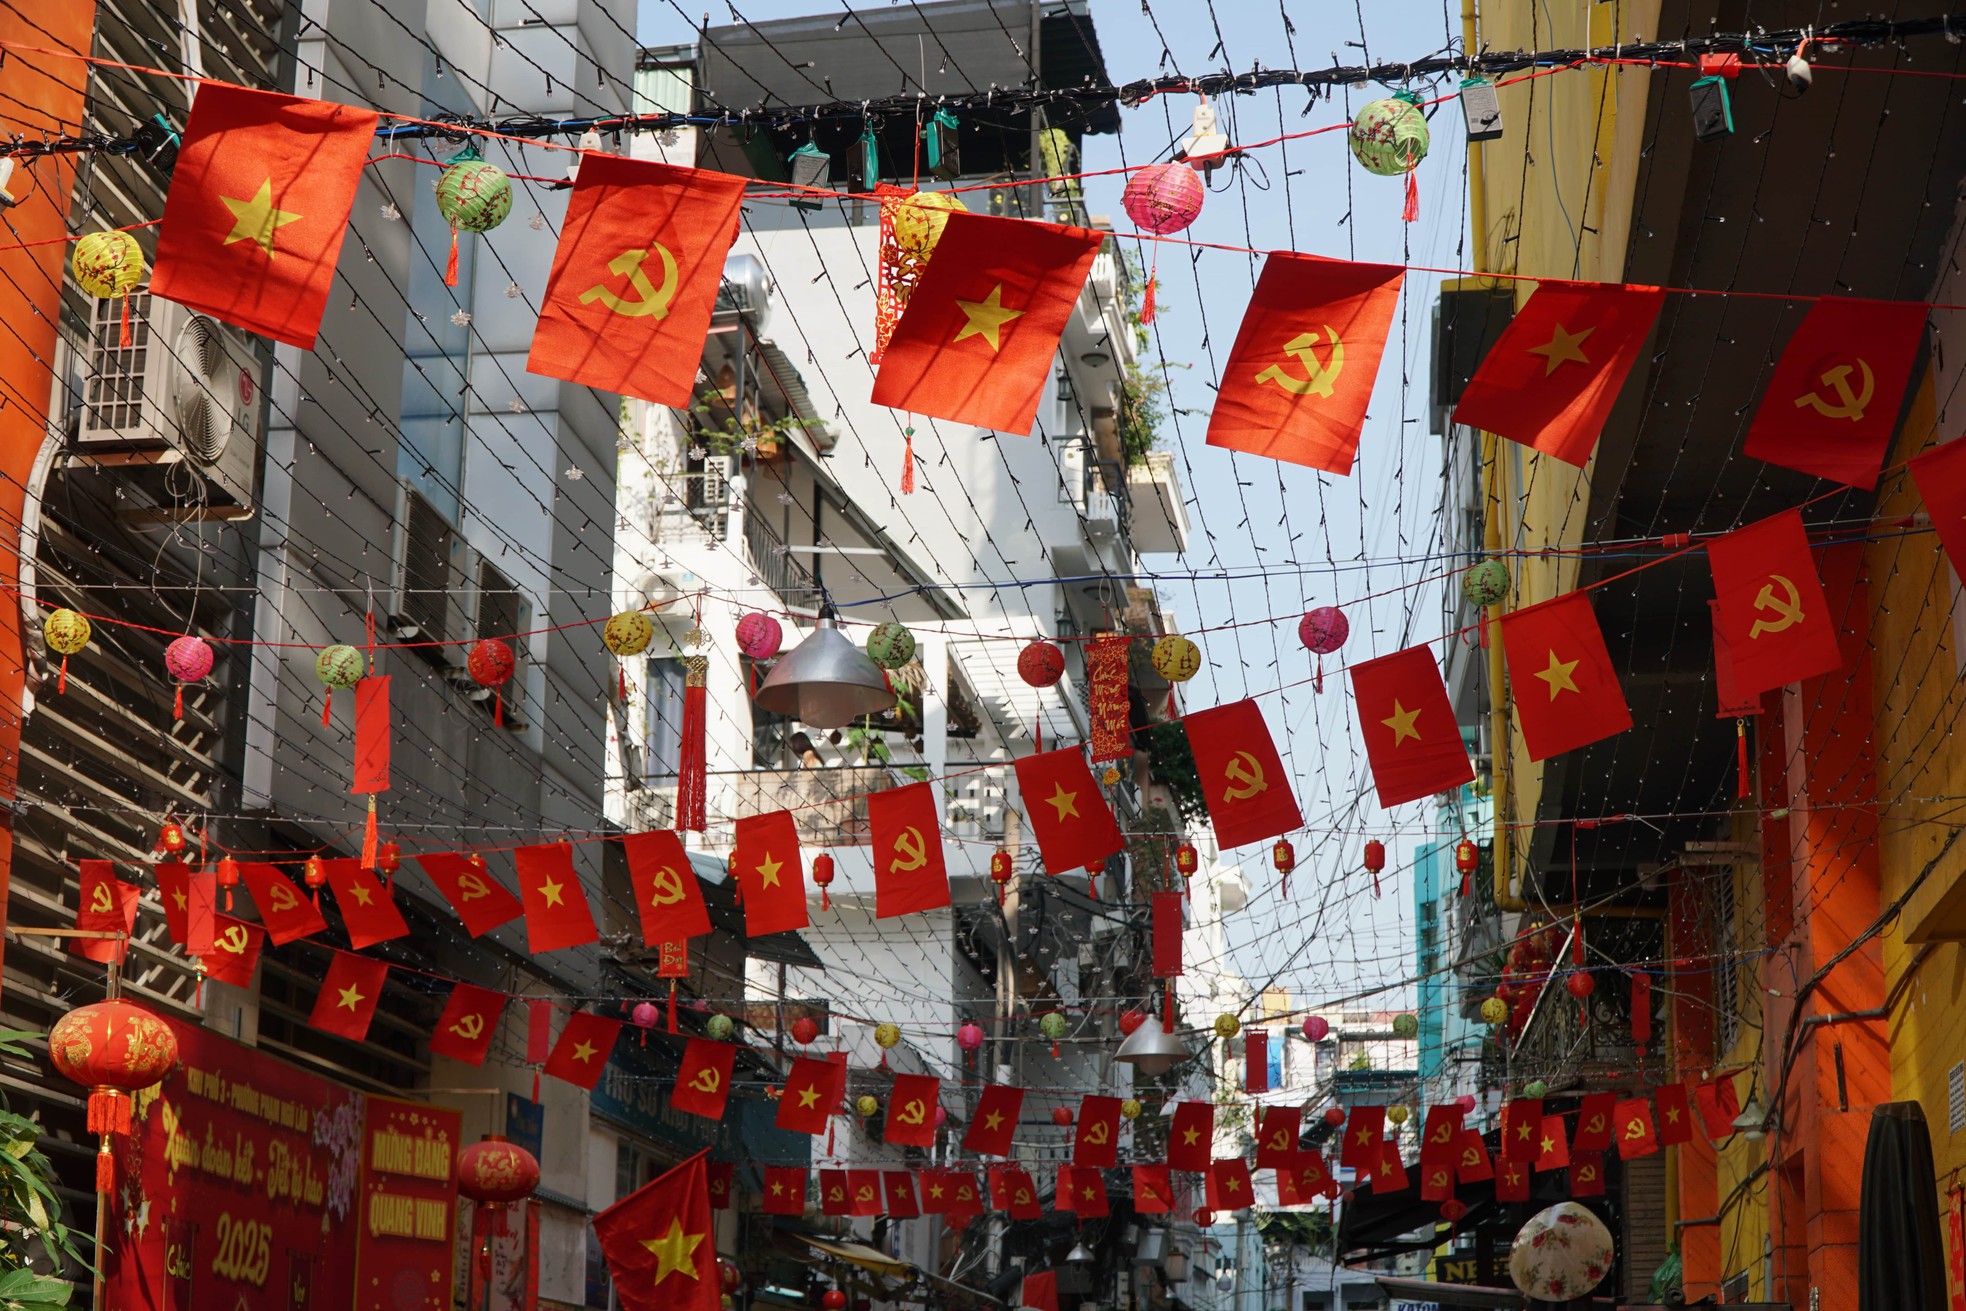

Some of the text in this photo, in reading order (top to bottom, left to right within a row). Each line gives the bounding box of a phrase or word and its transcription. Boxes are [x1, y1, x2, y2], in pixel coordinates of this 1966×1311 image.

[237, 408, 250, 432] LG
[187, 1066, 204, 1095] KHU
[219, 1079, 226, 1103] 3
[162, 1101, 200, 1173] Xuân
[202, 1121, 233, 1179] đoàn
[233, 1131, 255, 1185] kết
[267, 1138, 290, 1199] Tết
[303, 1154, 323, 1206] hào
[372, 1124, 413, 1175] MỪNG
[413, 1126, 450, 1181] ĐẢNG
[370, 1192, 447, 1240] QUANG VINH
[167, 1244, 191, 1280] Chúc
[212, 1211, 272, 1287] 2025
